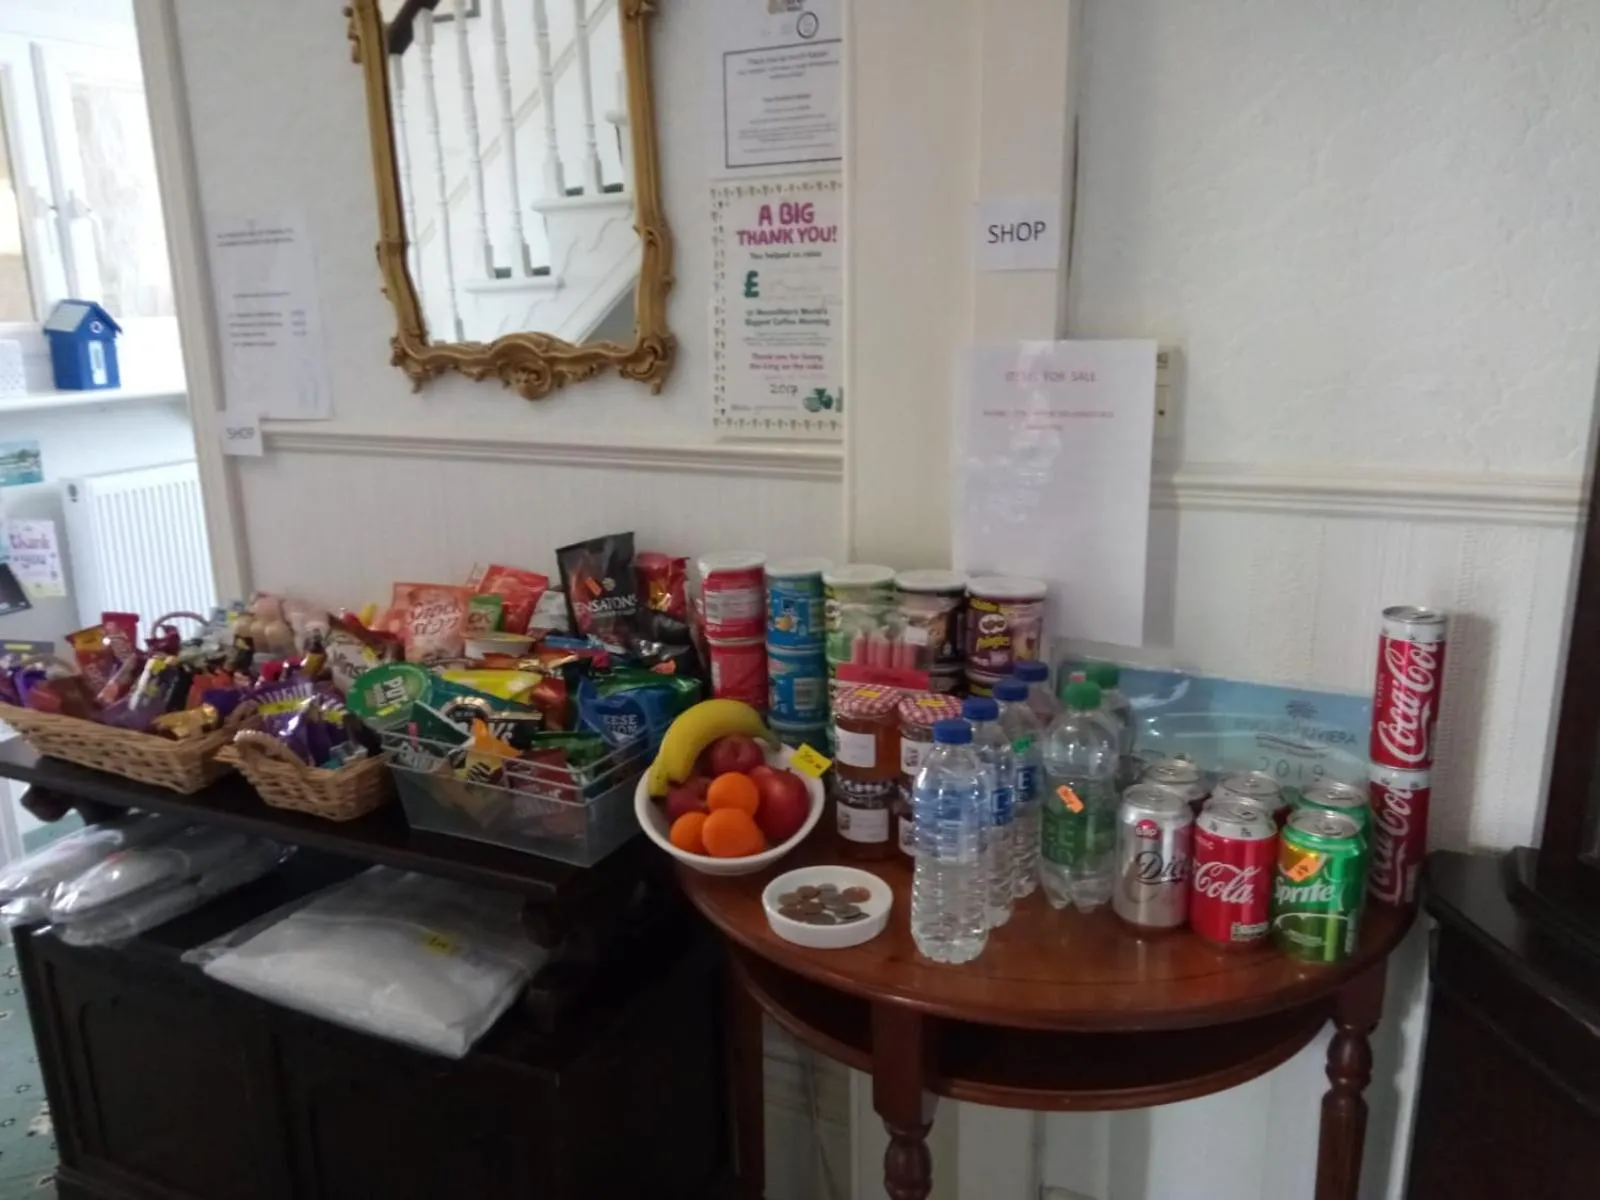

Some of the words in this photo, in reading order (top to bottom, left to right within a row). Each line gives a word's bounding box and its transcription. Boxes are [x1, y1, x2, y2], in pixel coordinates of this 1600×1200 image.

[758, 204, 773, 226] A
[779, 202, 815, 225] BIG
[736, 228, 794, 246] THANK
[797, 225, 838, 244] YOU!
[987, 221, 1046, 244] SHOP
[1194, 861, 1262, 904] Cola
